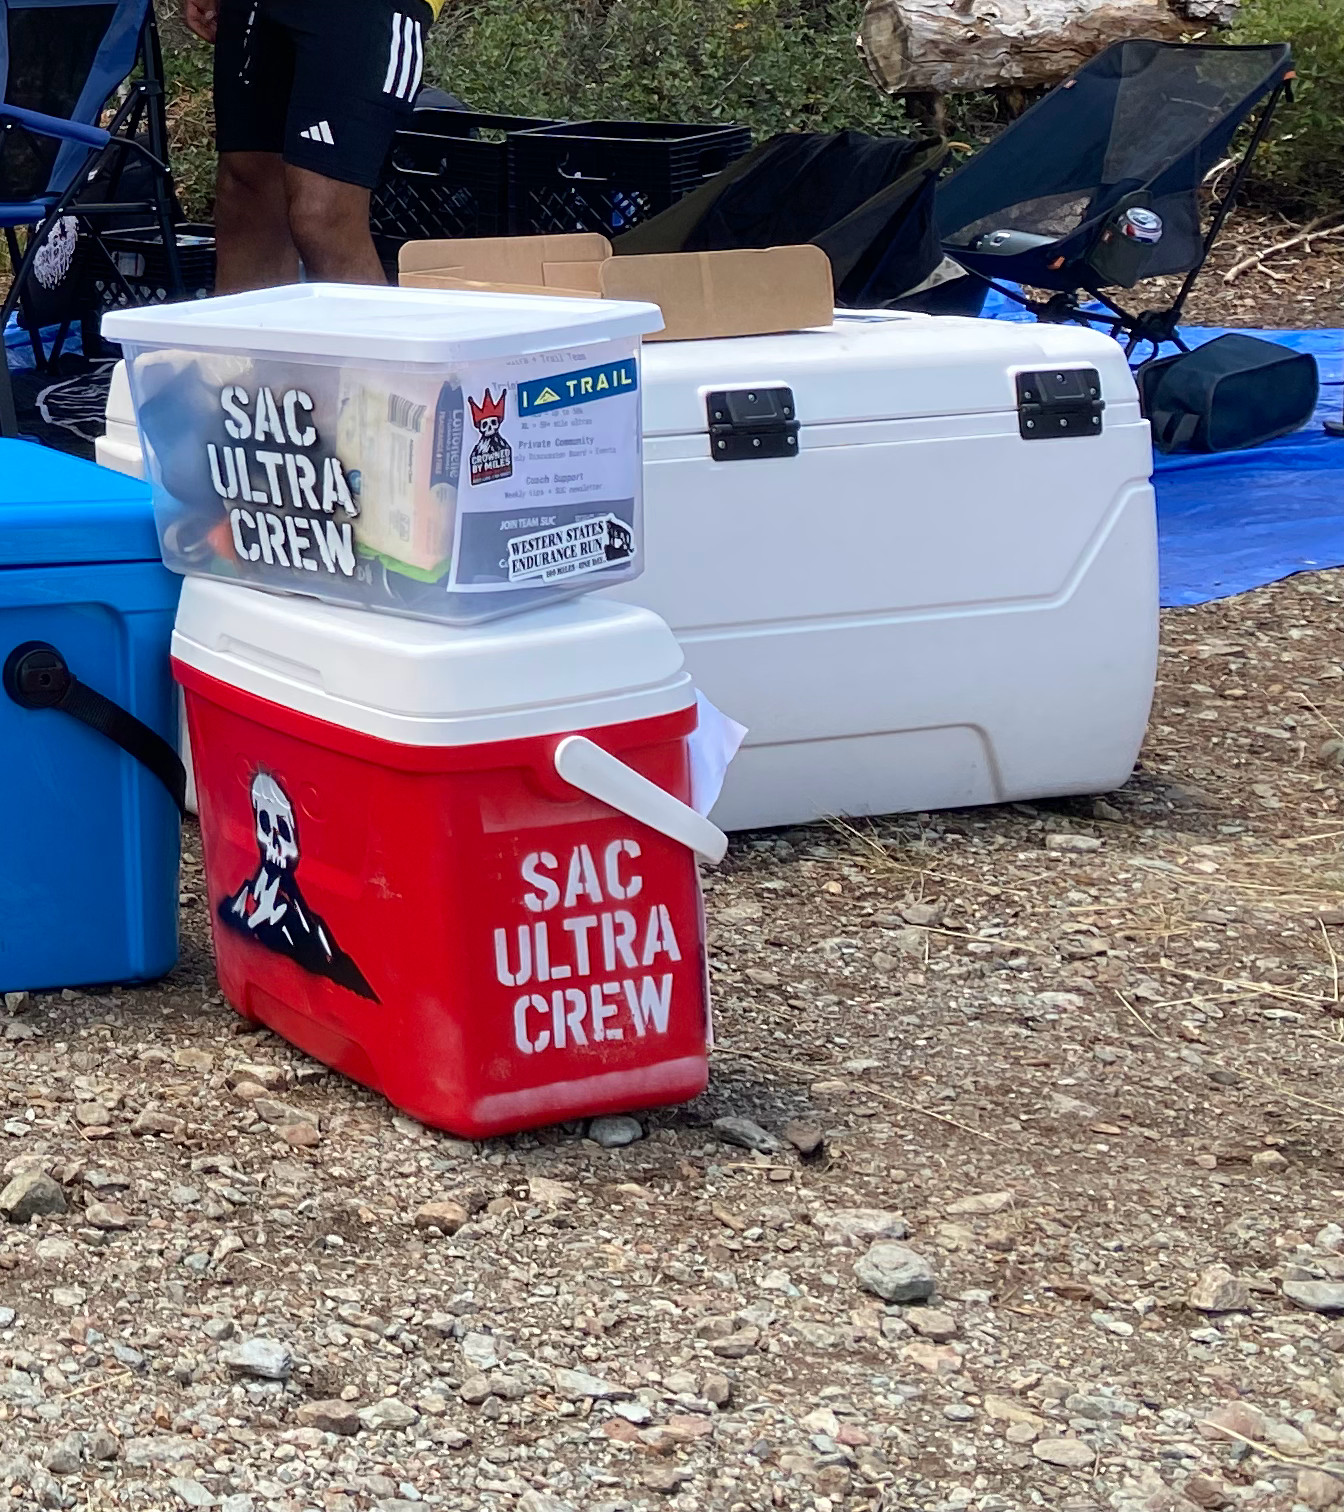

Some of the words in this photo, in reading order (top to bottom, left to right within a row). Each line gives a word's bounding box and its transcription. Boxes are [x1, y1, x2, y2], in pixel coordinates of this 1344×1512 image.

[522, 390, 529, 408] I
[565, 368, 633, 398] TRAIL
[219, 385, 318, 448] SAC
[518, 438, 552, 449] Private
[554, 435, 595, 447] Community
[206, 443, 358, 518] ULTRA
[484, 457, 511, 472] MILES
[525, 475, 550, 486] Coach
[554, 472, 584, 486] Support
[229, 508, 358, 579] CREW
[500, 519, 519, 531] JOIN
[519, 516, 539, 529] TEAM
[510, 530, 564, 556] WESTERN
[565, 520, 605, 543] STATES
[512, 544, 577, 574] ENDURANCE
[580, 537, 603, 556] RUN
[520, 838, 643, 913] SAC
[493, 904, 682, 987] ULTRA
[514, 973, 675, 1054] CREW
